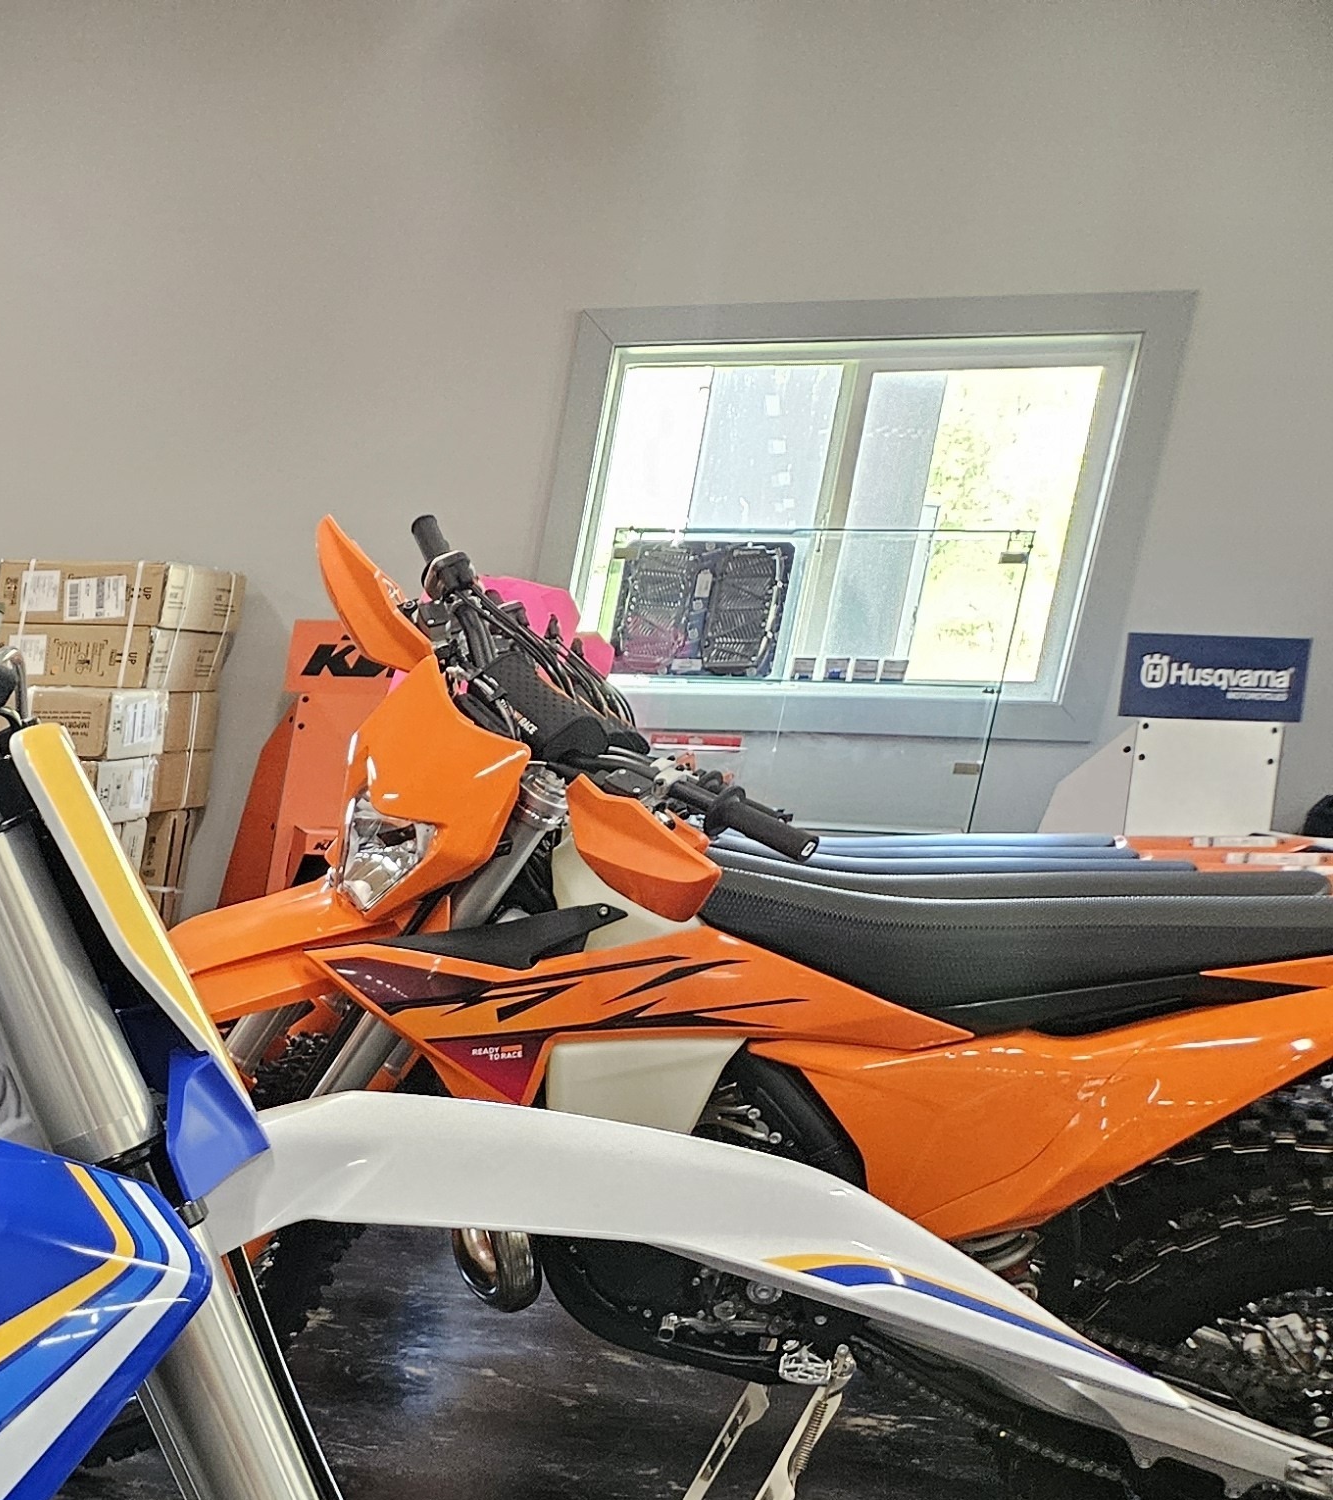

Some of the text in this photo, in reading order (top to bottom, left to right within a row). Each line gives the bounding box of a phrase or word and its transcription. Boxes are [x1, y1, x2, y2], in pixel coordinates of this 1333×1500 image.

[128, 652, 138, 665] UP
[1169, 660, 1295, 691] Husqvarna
[472, 1046, 500, 1056] READY
[489, 1051, 523, 1061] TO RACE
